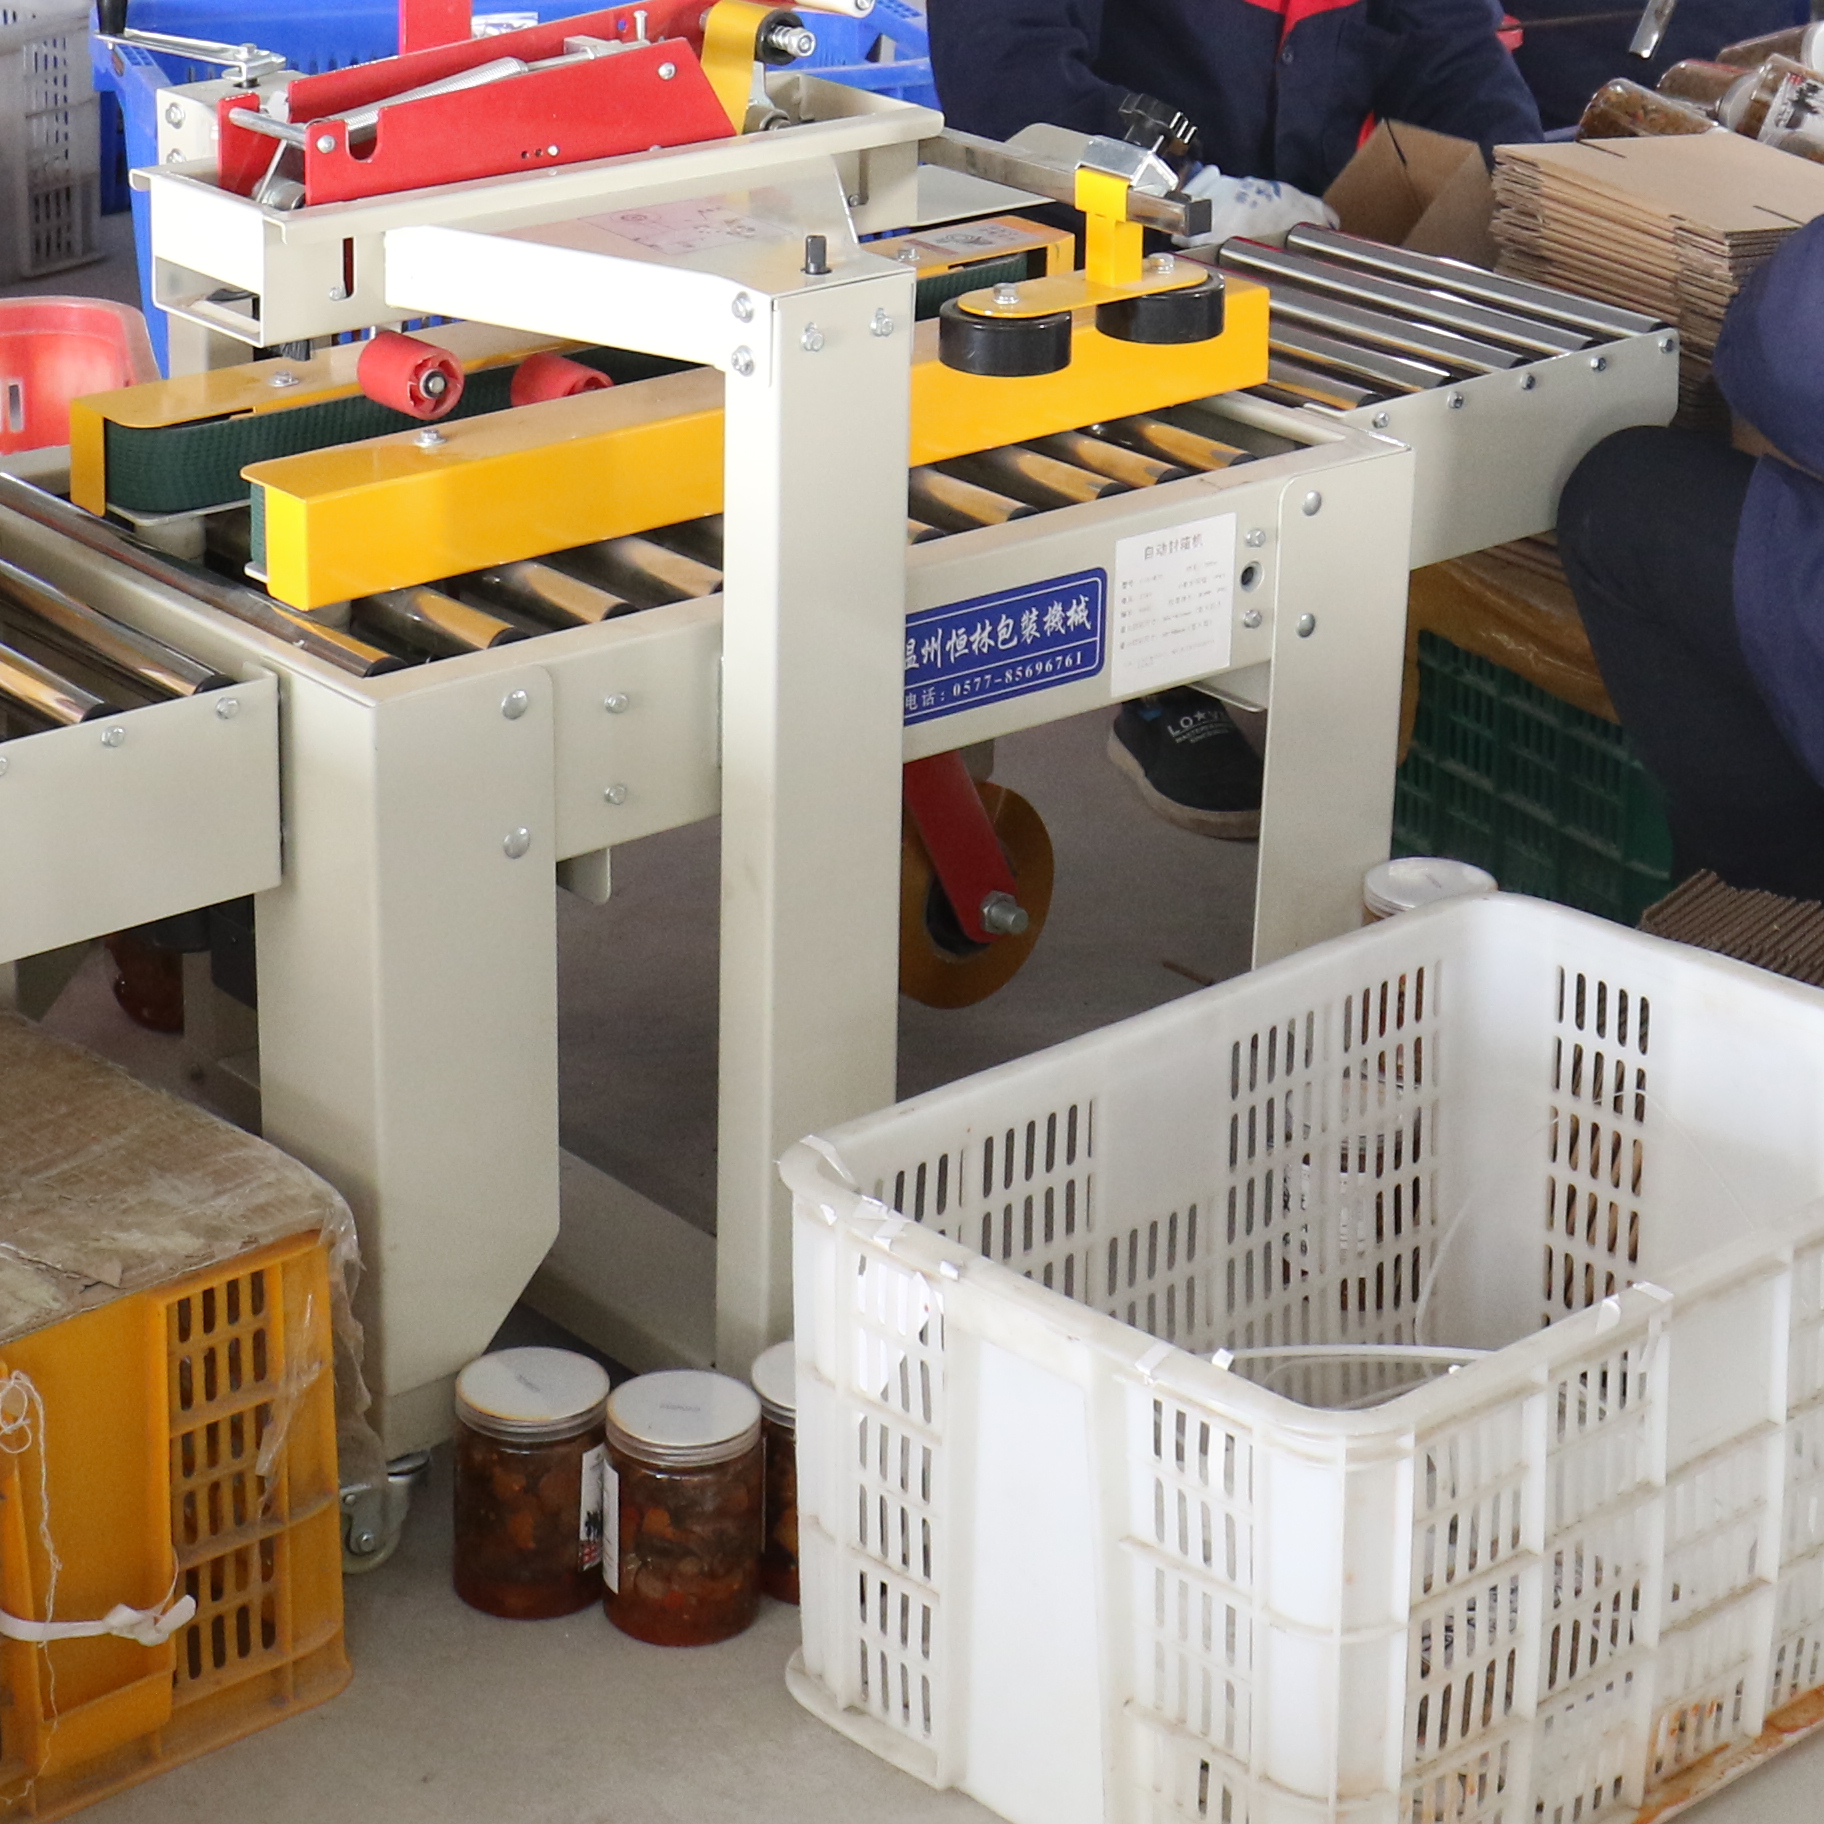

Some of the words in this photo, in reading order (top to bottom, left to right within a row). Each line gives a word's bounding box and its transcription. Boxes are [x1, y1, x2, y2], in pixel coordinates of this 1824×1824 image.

[1143, 533, 1204, 561] 自动封箱机
